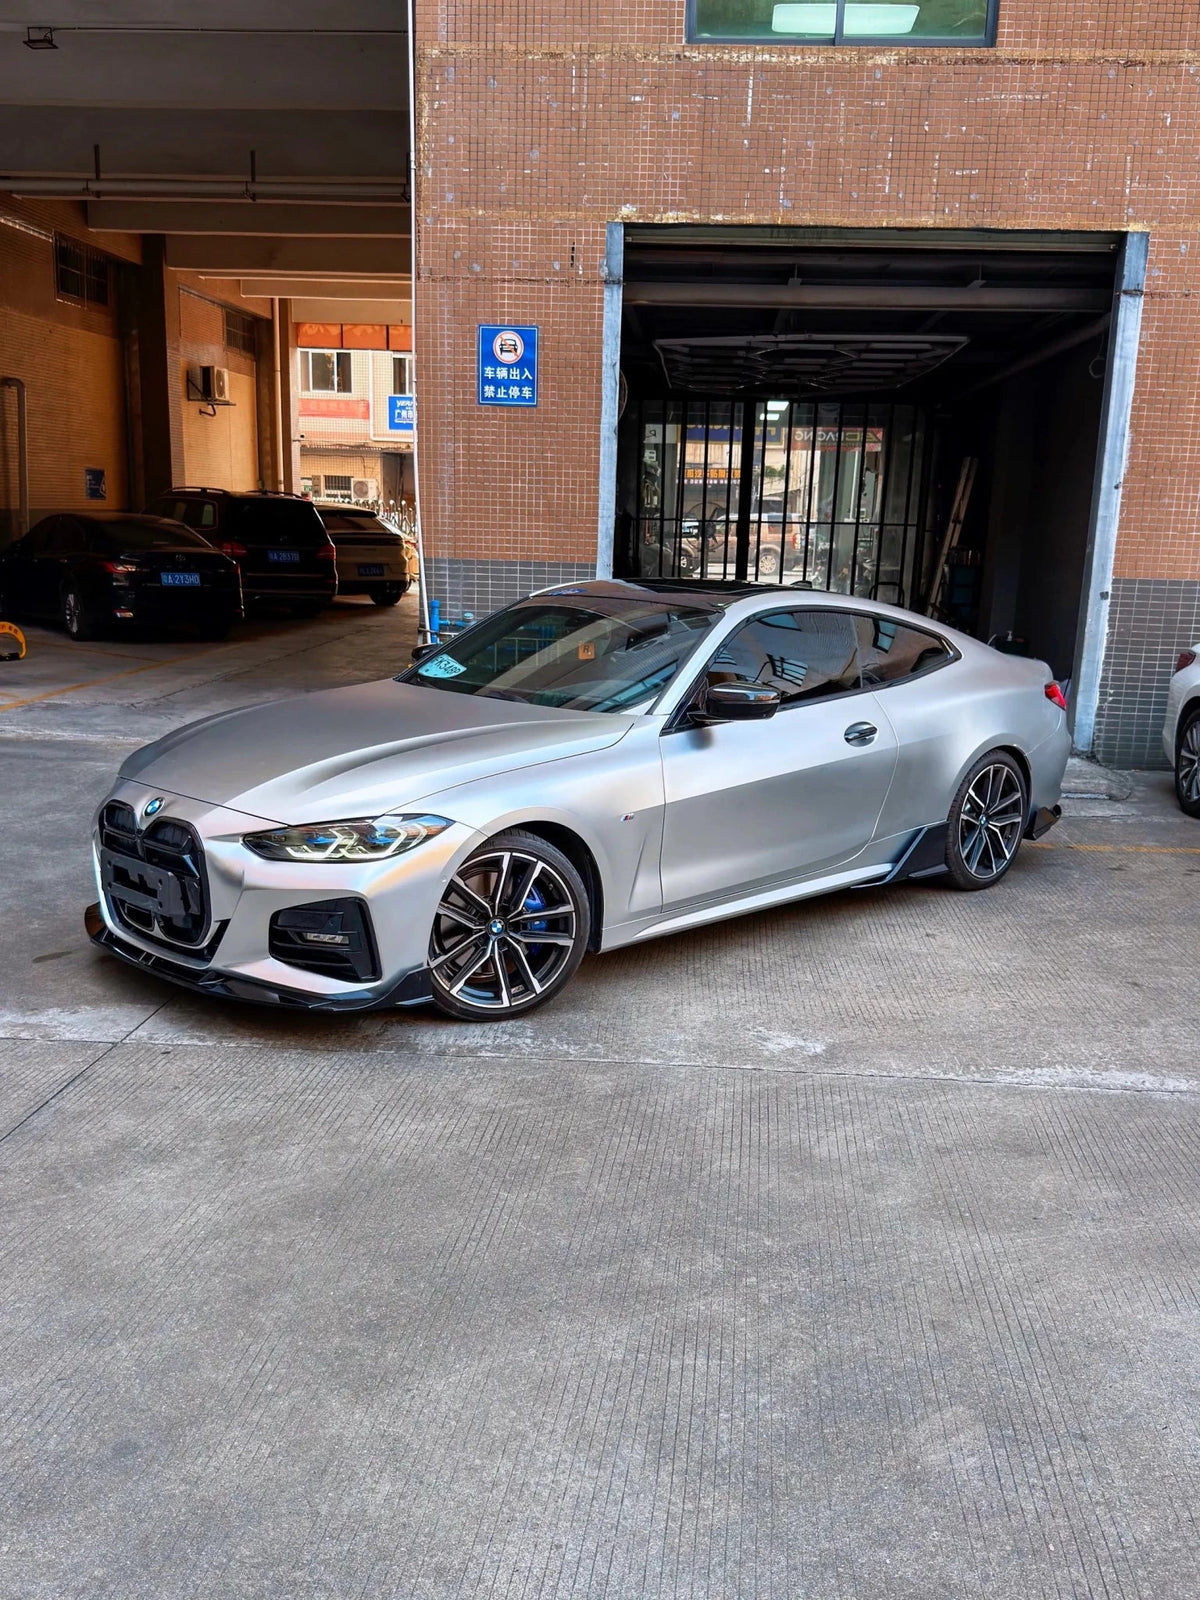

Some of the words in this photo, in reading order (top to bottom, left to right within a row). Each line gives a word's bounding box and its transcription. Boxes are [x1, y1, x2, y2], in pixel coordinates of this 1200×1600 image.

[483, 366, 533, 380] 车辆出入
[483, 384, 533, 400] 禁止停车
